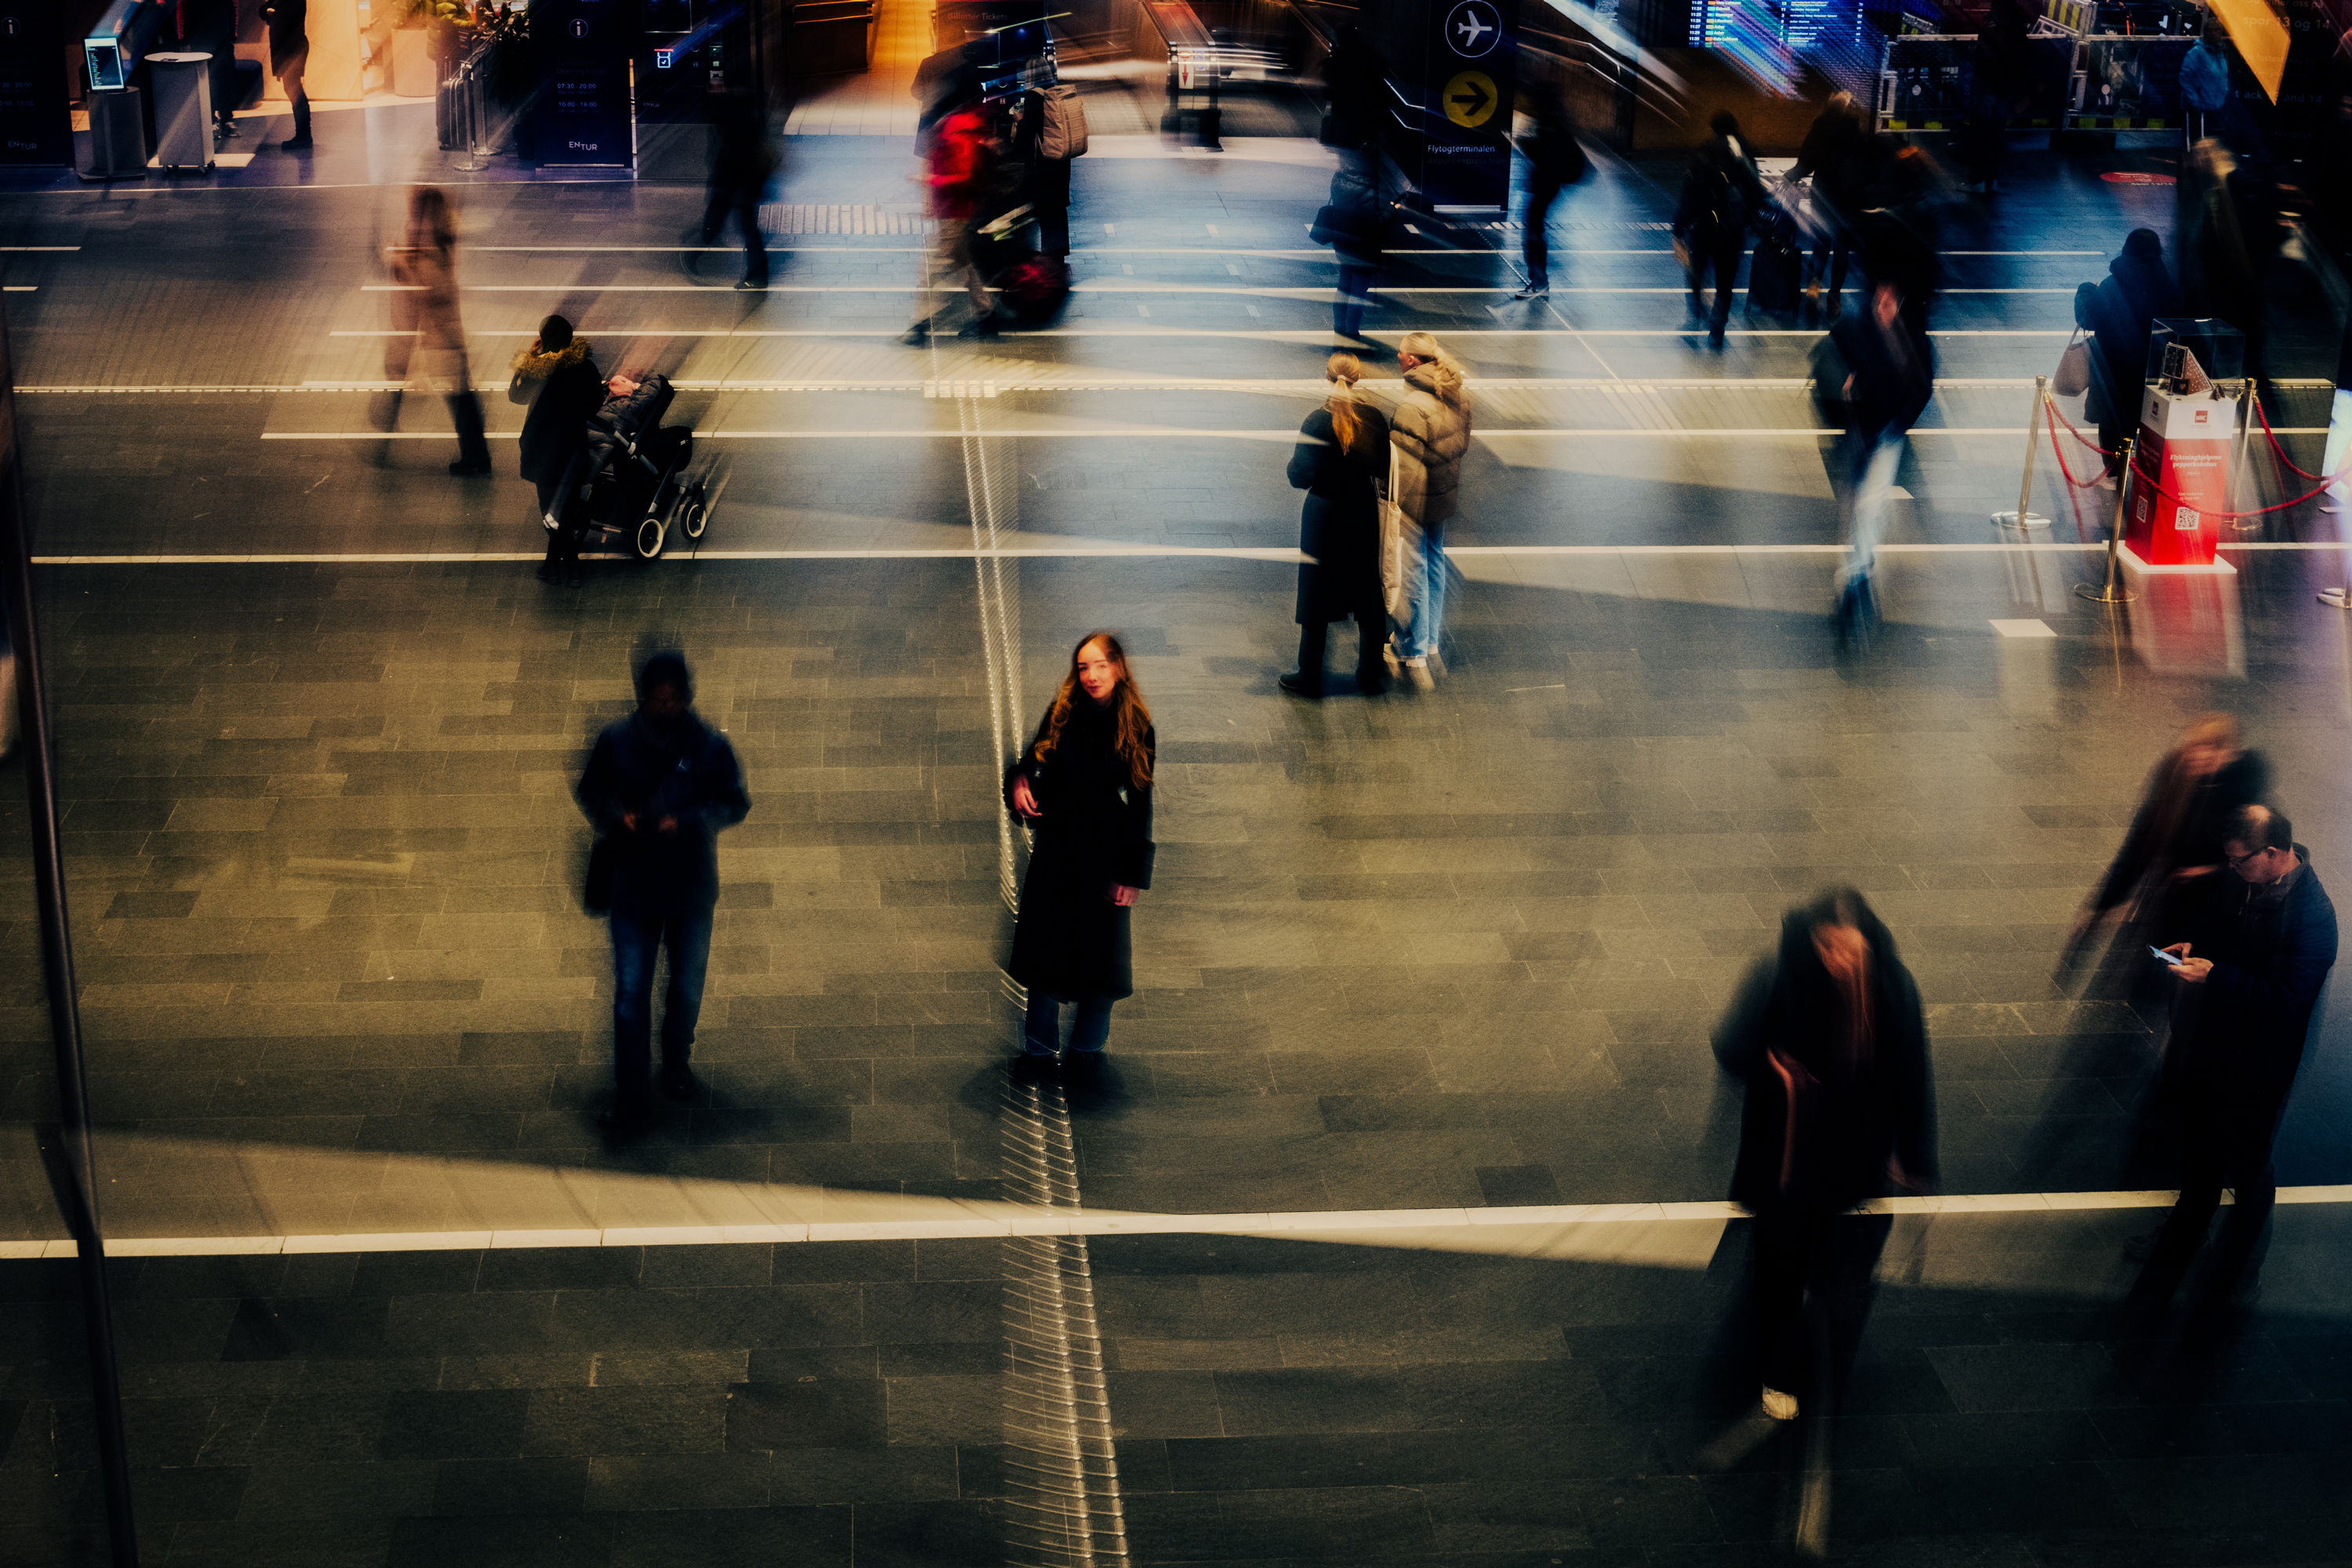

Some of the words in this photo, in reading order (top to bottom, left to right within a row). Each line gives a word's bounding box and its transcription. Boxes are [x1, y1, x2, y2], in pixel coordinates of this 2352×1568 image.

[2294, 20, 2310, 31] og
[2315, 18, 2330, 30] 14
[568, 141, 597, 151] ENTUR
[1427, 144, 1496, 154] Flytogterminalen
